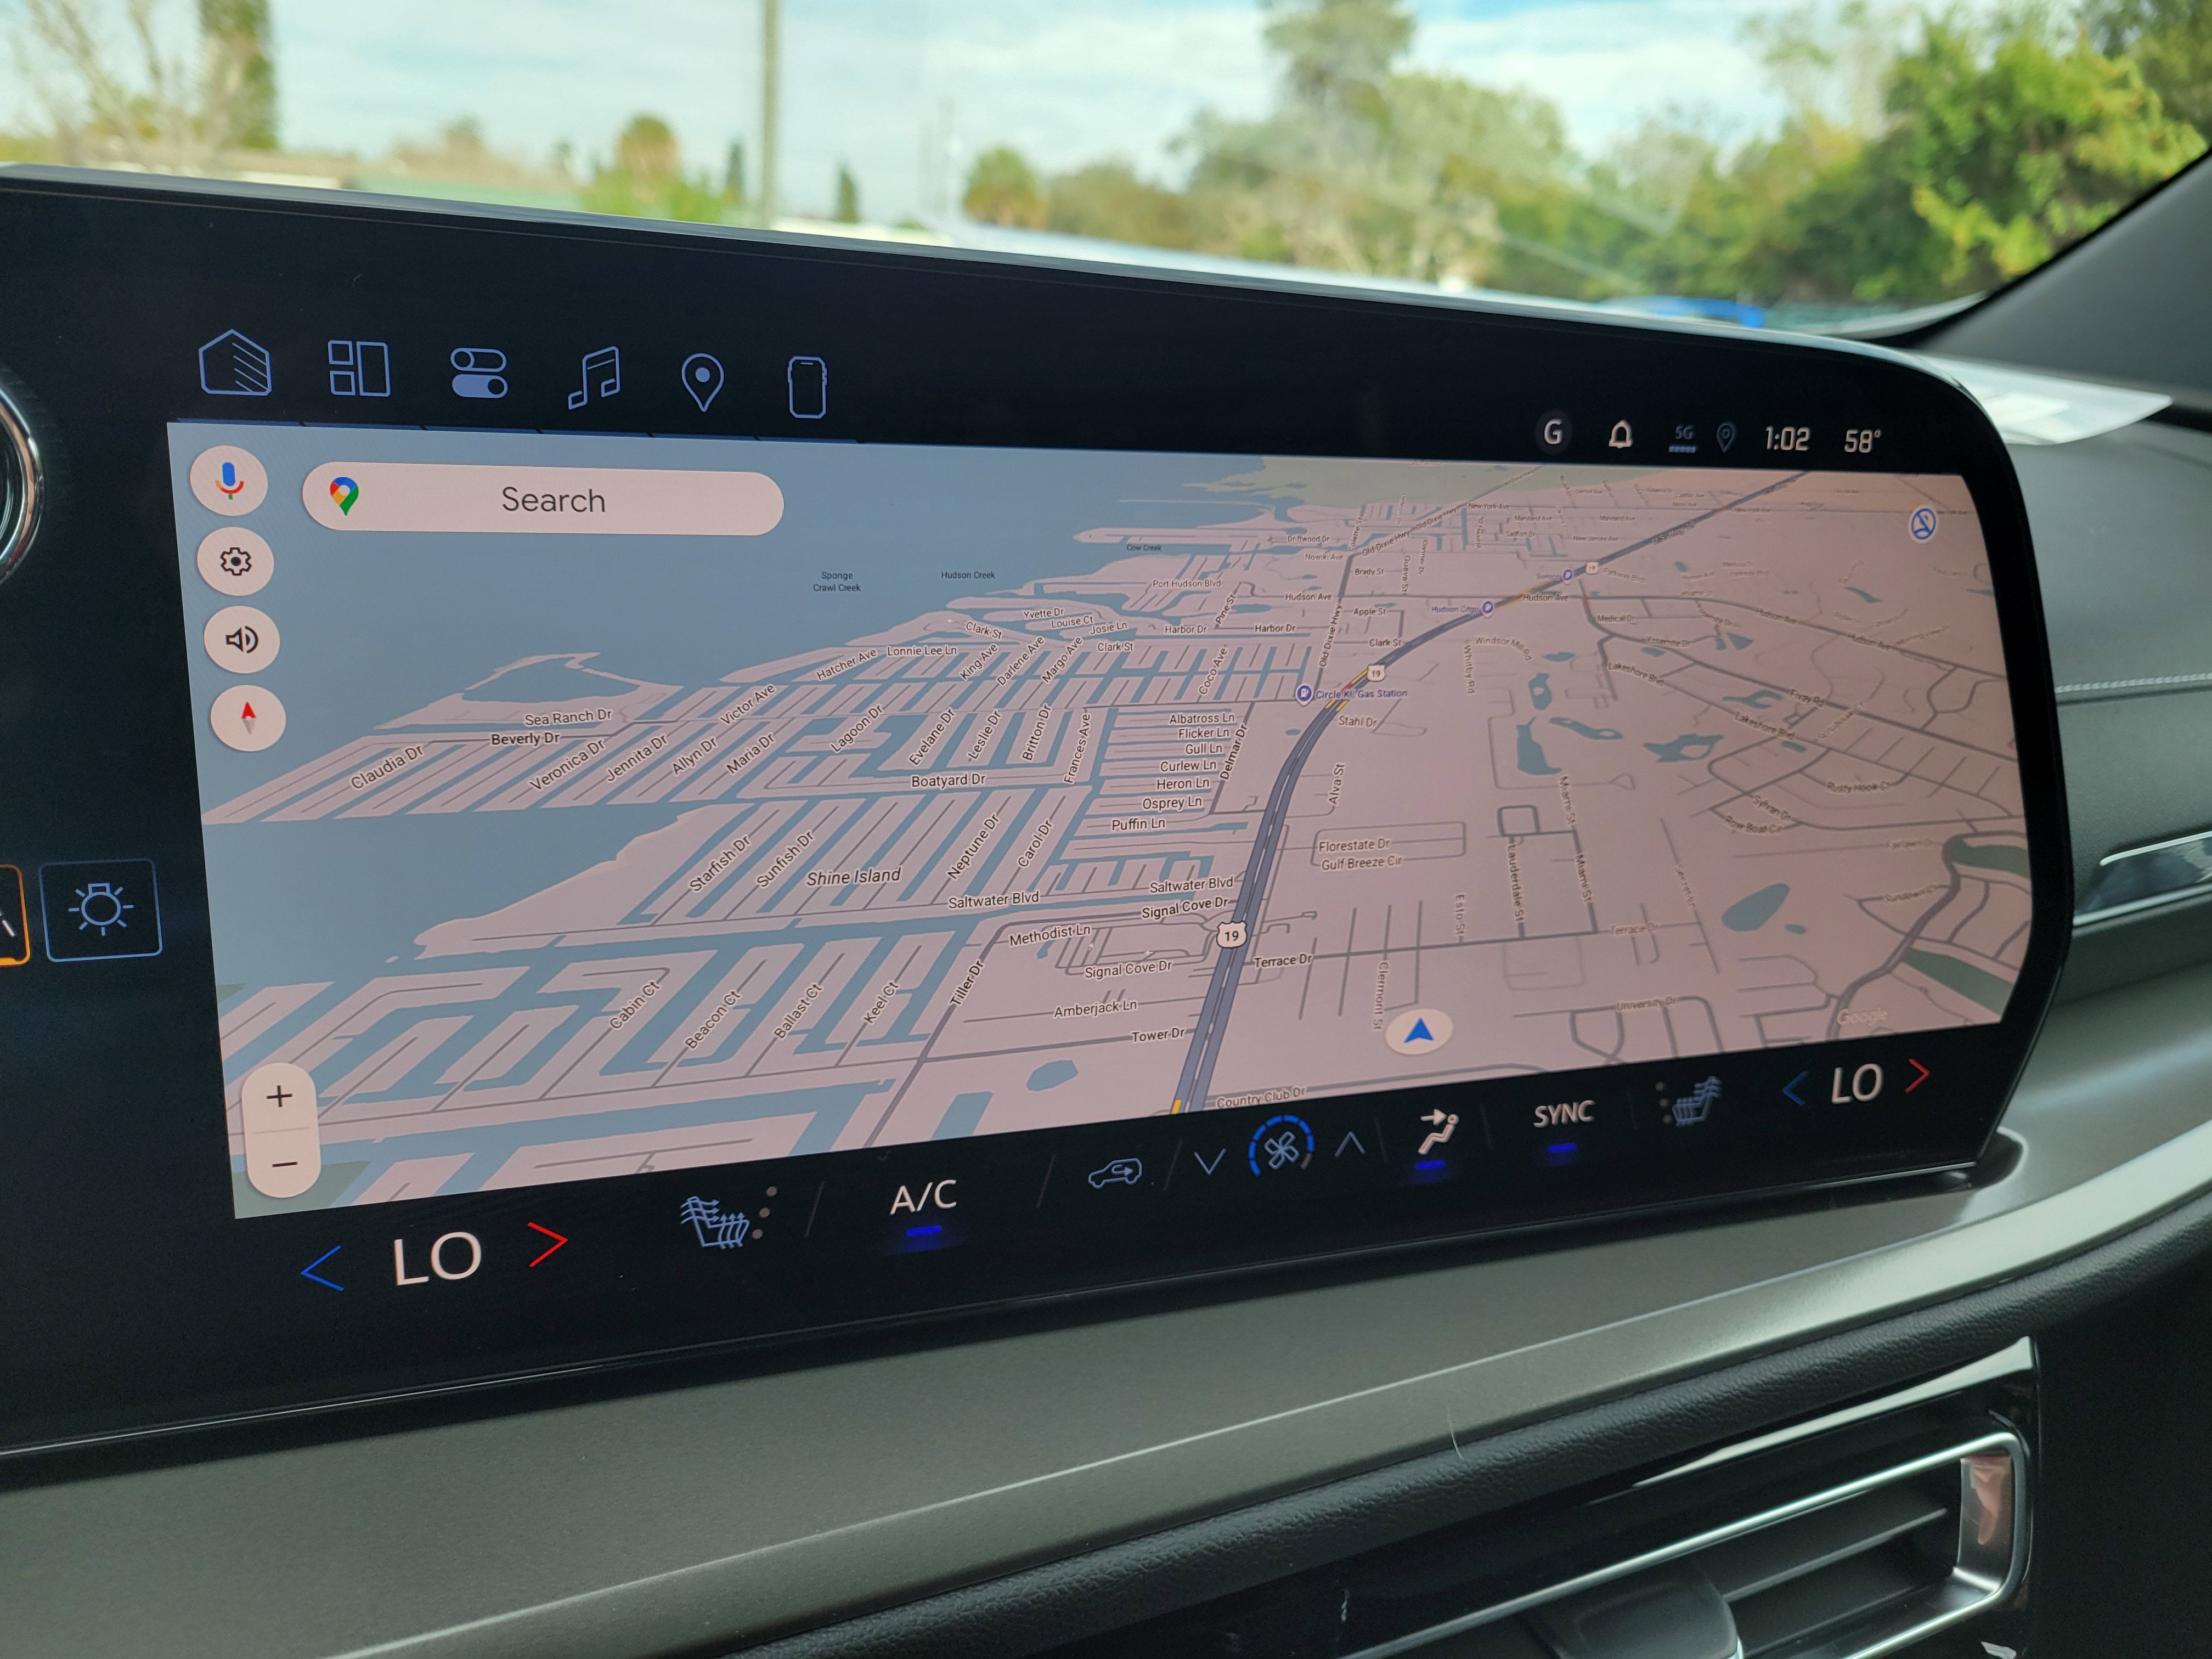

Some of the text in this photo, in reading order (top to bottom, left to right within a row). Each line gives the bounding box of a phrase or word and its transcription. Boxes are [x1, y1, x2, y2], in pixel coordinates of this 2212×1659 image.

[1675, 425, 1695, 439] 5G
[1765, 426, 1810, 451] 1:02
[502, 486, 605, 512] Search
[1362, 530, 1410, 556] Old Dixie Hwy
[1024, 608, 1064, 619] Yvette Dr
[1215, 594, 1237, 624] Pine St
[966, 622, 1002, 639] Clark St
[1052, 616, 1093, 629] Louise Ct
[1091, 621, 1127, 635] Josie Ln
[1320, 605, 1342, 667] Old Dixie Hwy
[888, 646, 957, 656] Lonnie Lee Ln
[960, 644, 997, 680] King Ave
[997, 636, 1045, 686] Darlene Ave
[1042, 636, 1082, 683] Margo Ave
[817, 649, 877, 680] Hatcher Ave
[1199, 648, 1228, 695] Coco Ave
[720, 684, 775, 724] Victor Ave
[1378, 689, 1407, 697] Station
[525, 709, 612, 725] Sea Ranch Dr
[831, 704, 884, 752] Lagoon Dr
[1170, 713, 1234, 724] Albatross Ln
[1338, 715, 1377, 726] Stahl Dr
[492, 732, 560, 746] Beverly Dr
[909, 708, 956, 765] Evelane Dr
[1022, 703, 1052, 761] Britton Dr
[1179, 729, 1229, 738] Flicker Ln
[607, 735, 668, 782] Jennita Dr
[726, 733, 775, 774] Maria Dr
[1064, 713, 1091, 783] Frances Ave
[1220, 724, 1248, 780] Delmar Dr
[351, 744, 424, 789] Claudia Dr
[530, 740, 605, 790] Veronica Dr
[1160, 760, 1216, 771] Curlew Ln
[911, 773, 985, 788] Boatyard Dr
[1329, 764, 1345, 805] Alva St
[1143, 797, 1201, 811] Osprey Ln
[1112, 818, 1165, 831] Puffin Ln
[947, 814, 1000, 879] Neptune Dr
[1018, 820, 1052, 868] Carol Dr
[1319, 838, 1390, 853] Florestate Dr
[757, 830, 814, 887] Sunfish Dr
[1322, 855, 1402, 870] Gulf Breeze Cir
[806, 867, 901, 886] Shine Island
[949, 891, 1039, 909] Saltwater Blvd
[1142, 897, 1228, 919] Signal Cove Dr
[1010, 925, 1091, 945] Methodist Ln
[1224, 931, 1239, 941] 19
[1254, 953, 1312, 968] Terrace Dr
[950, 960, 984, 1006] Tiller Dr
[610, 980, 660, 1030] Cabin Ct
[864, 980, 899, 1024] Keel Ct
[1054, 1000, 1137, 1018] Amberjack Ln
[685, 990, 741, 1049] Beacon Ct
[1132, 1029, 1185, 1042] Tower Dr
[1831, 1063, 1883, 1104] LO
[1217, 1087, 1306, 1108] Country Club Dr
[1534, 1100, 1595, 1128] SYNC
[890, 1180, 957, 1215] A/C
[394, 1232, 481, 1286] LO
